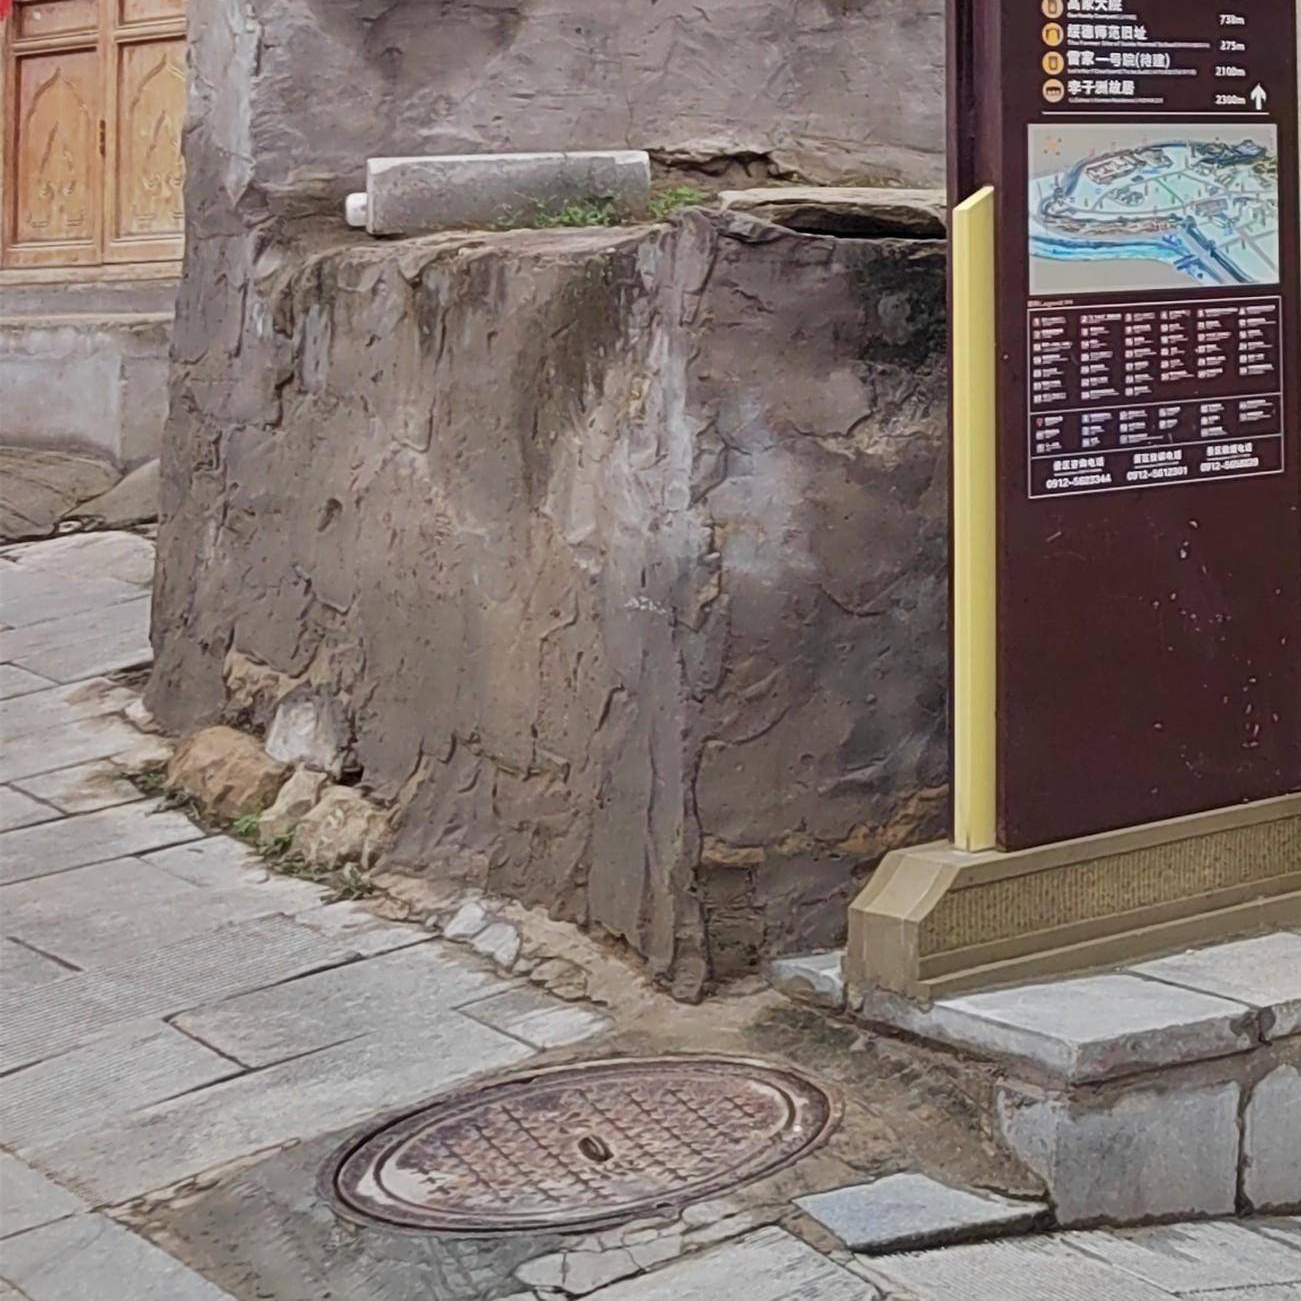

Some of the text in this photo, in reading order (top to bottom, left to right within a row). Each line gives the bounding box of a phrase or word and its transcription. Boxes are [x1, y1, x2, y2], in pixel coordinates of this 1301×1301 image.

[1067, 23, 1147, 41] 绥德师范旧址
